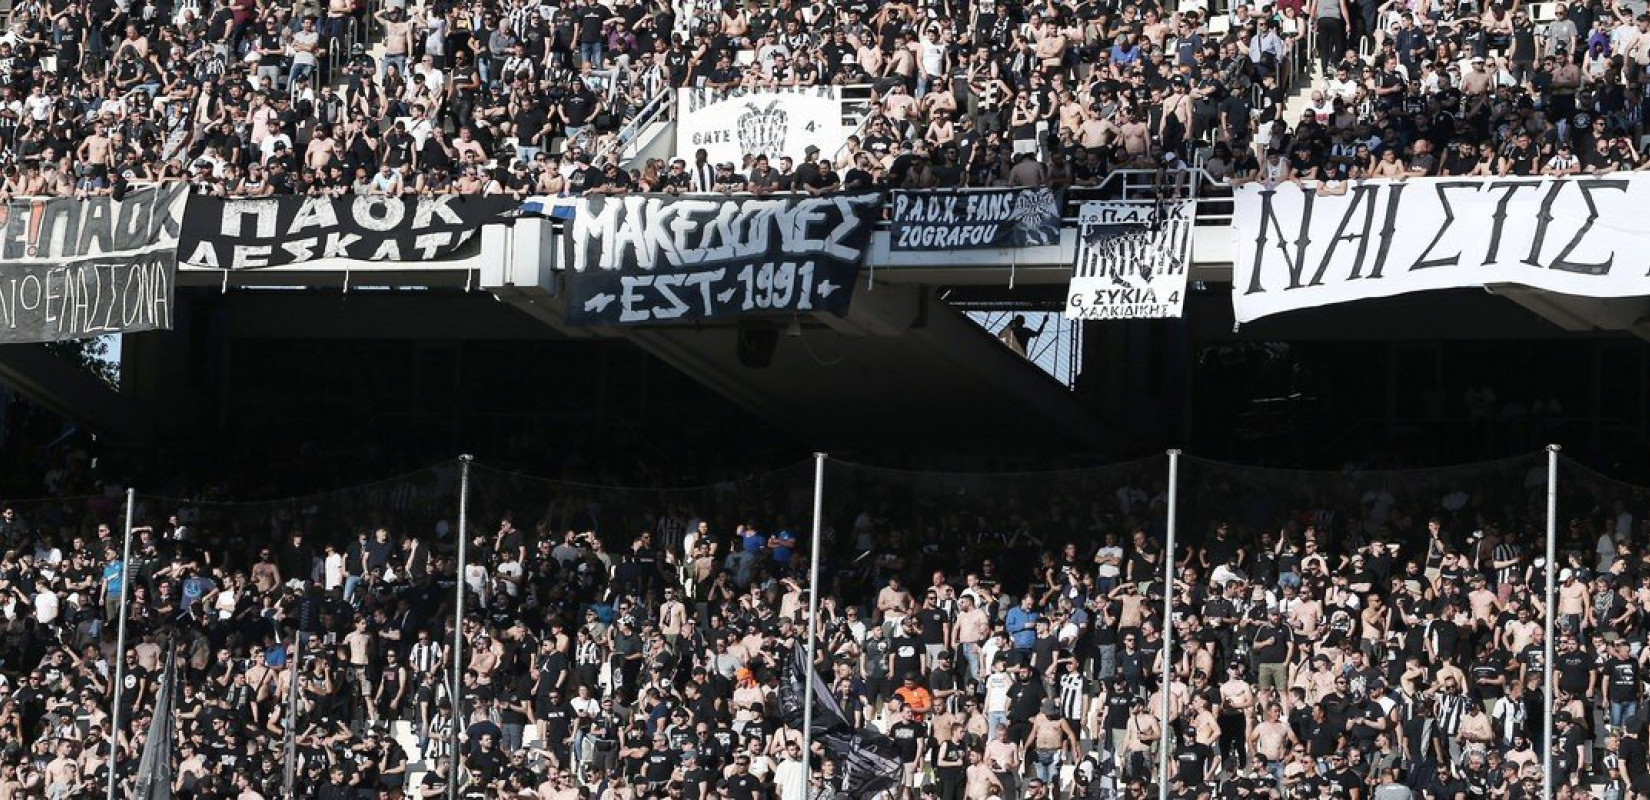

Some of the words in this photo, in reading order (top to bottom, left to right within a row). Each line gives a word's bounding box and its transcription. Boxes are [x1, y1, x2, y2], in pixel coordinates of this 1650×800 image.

[692, 129, 731, 145] GATE
[220, 194, 463, 238] ΠΑΟΚ
[966, 193, 1013, 221] FANS
[898, 224, 999, 248] ZOGRAFOU
[1244, 183, 1409, 296] ΝΑΙ
[1409, 180, 1629, 275] ΣΤΙΣ
[736, 261, 815, 311] 1991
[1070, 293, 1083, 307] G
[1093, 287, 1157, 305] ΣΥΚΙΑ
[1168, 290, 1179, 305] 4
[1079, 304, 1169, 317] ΧΑΛΚΙΔΙΚΗΣ
